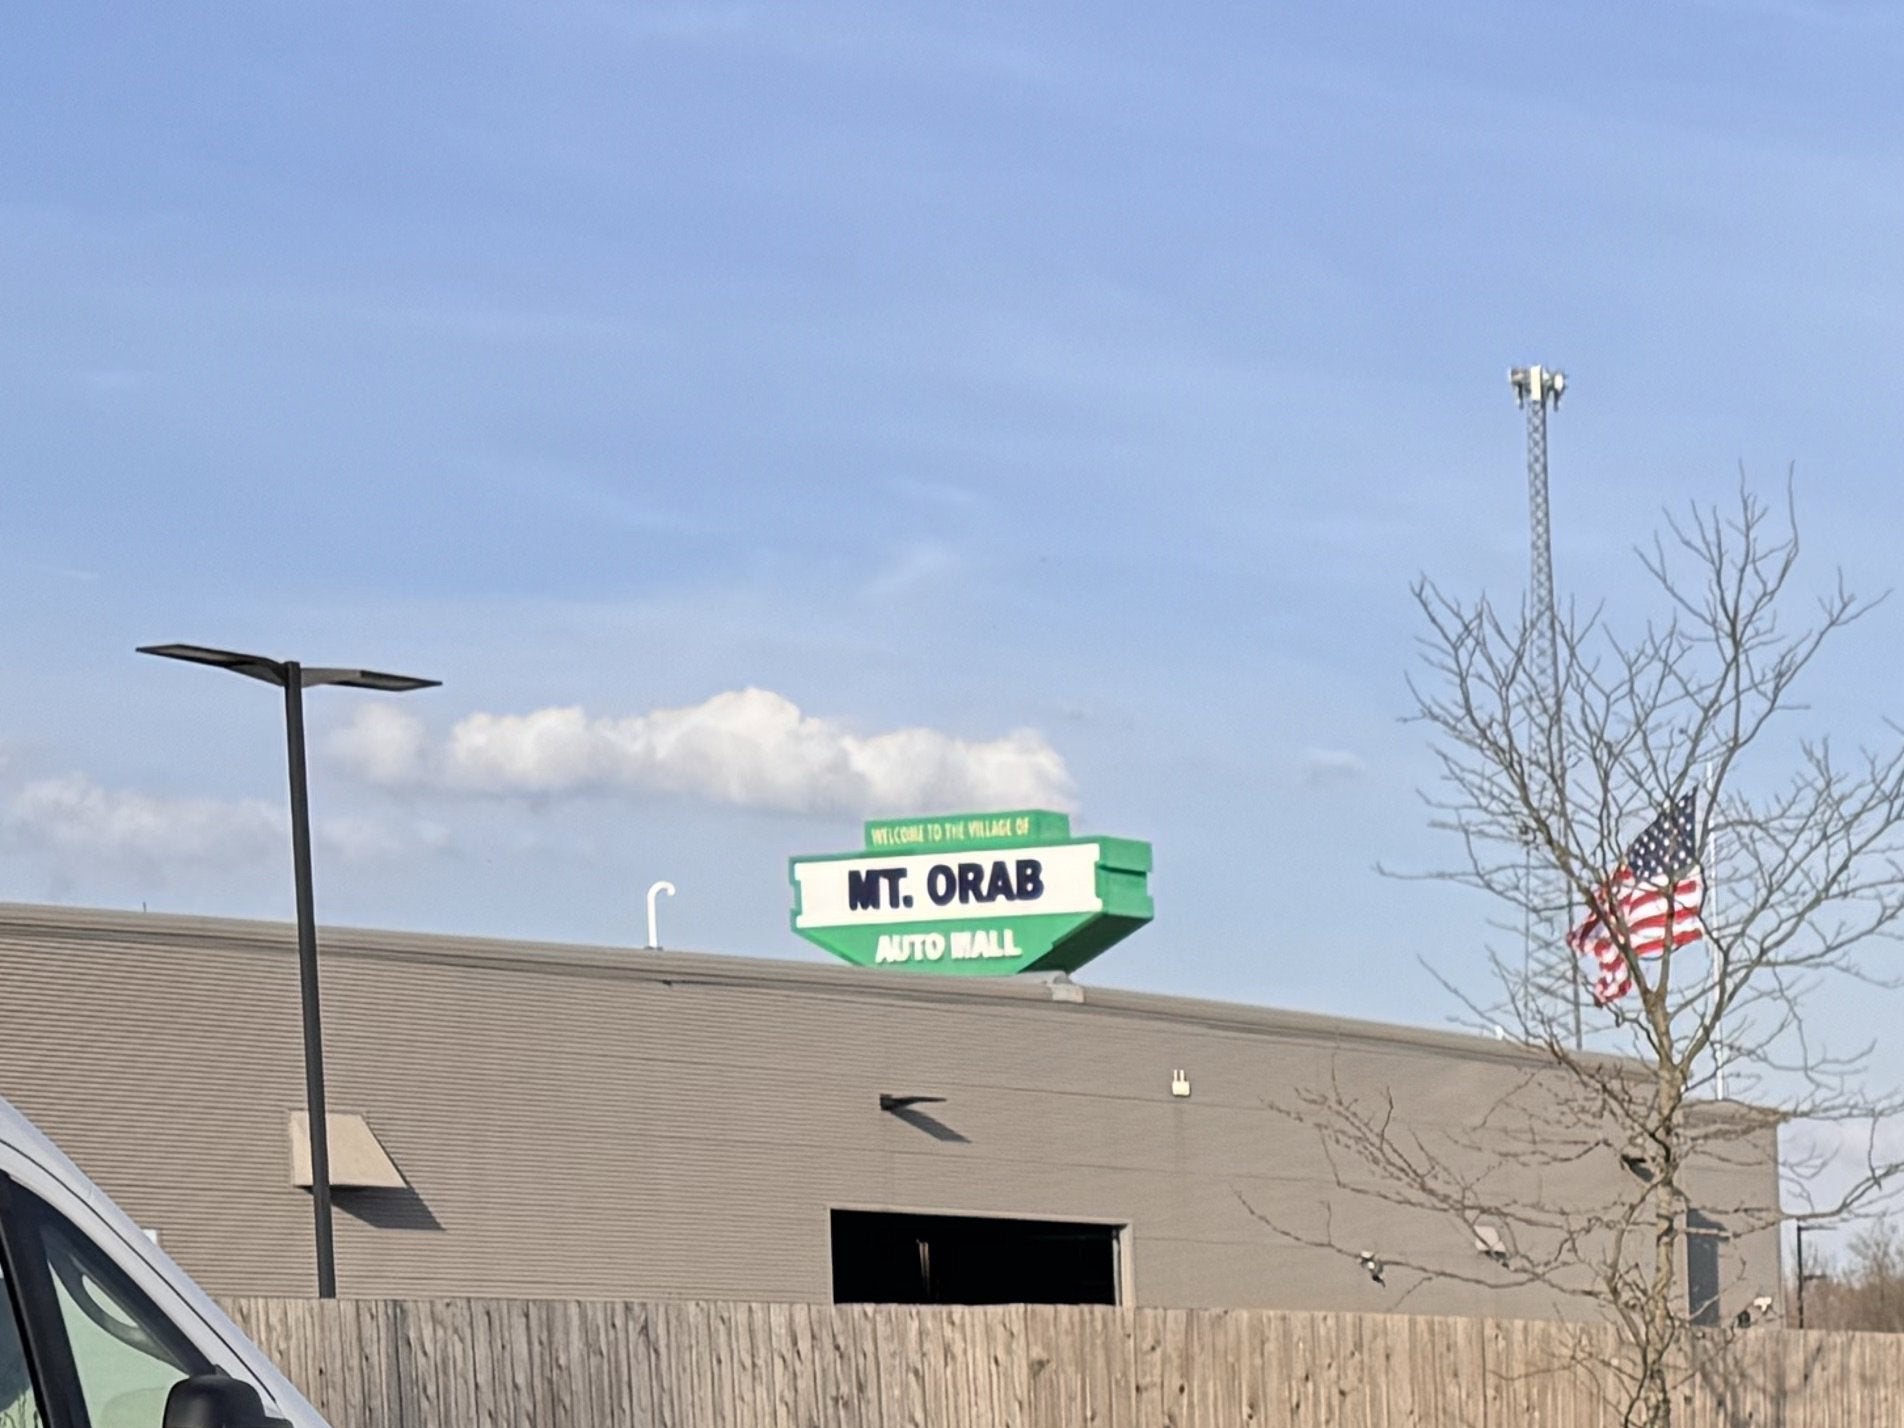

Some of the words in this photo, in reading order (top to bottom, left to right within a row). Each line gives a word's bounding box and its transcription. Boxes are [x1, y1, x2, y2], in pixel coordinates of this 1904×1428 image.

[871, 823, 924, 847] WELCOME
[928, 822, 942, 841] TO
[945, 820, 965, 840] THE
[968, 818, 1012, 839] VILLAGE
[1016, 816, 1030, 836] OF
[848, 867, 914, 911] MT.
[927, 858, 1044, 907] ORAB
[876, 932, 947, 963] AUTO
[950, 929, 1024, 961] MALL
